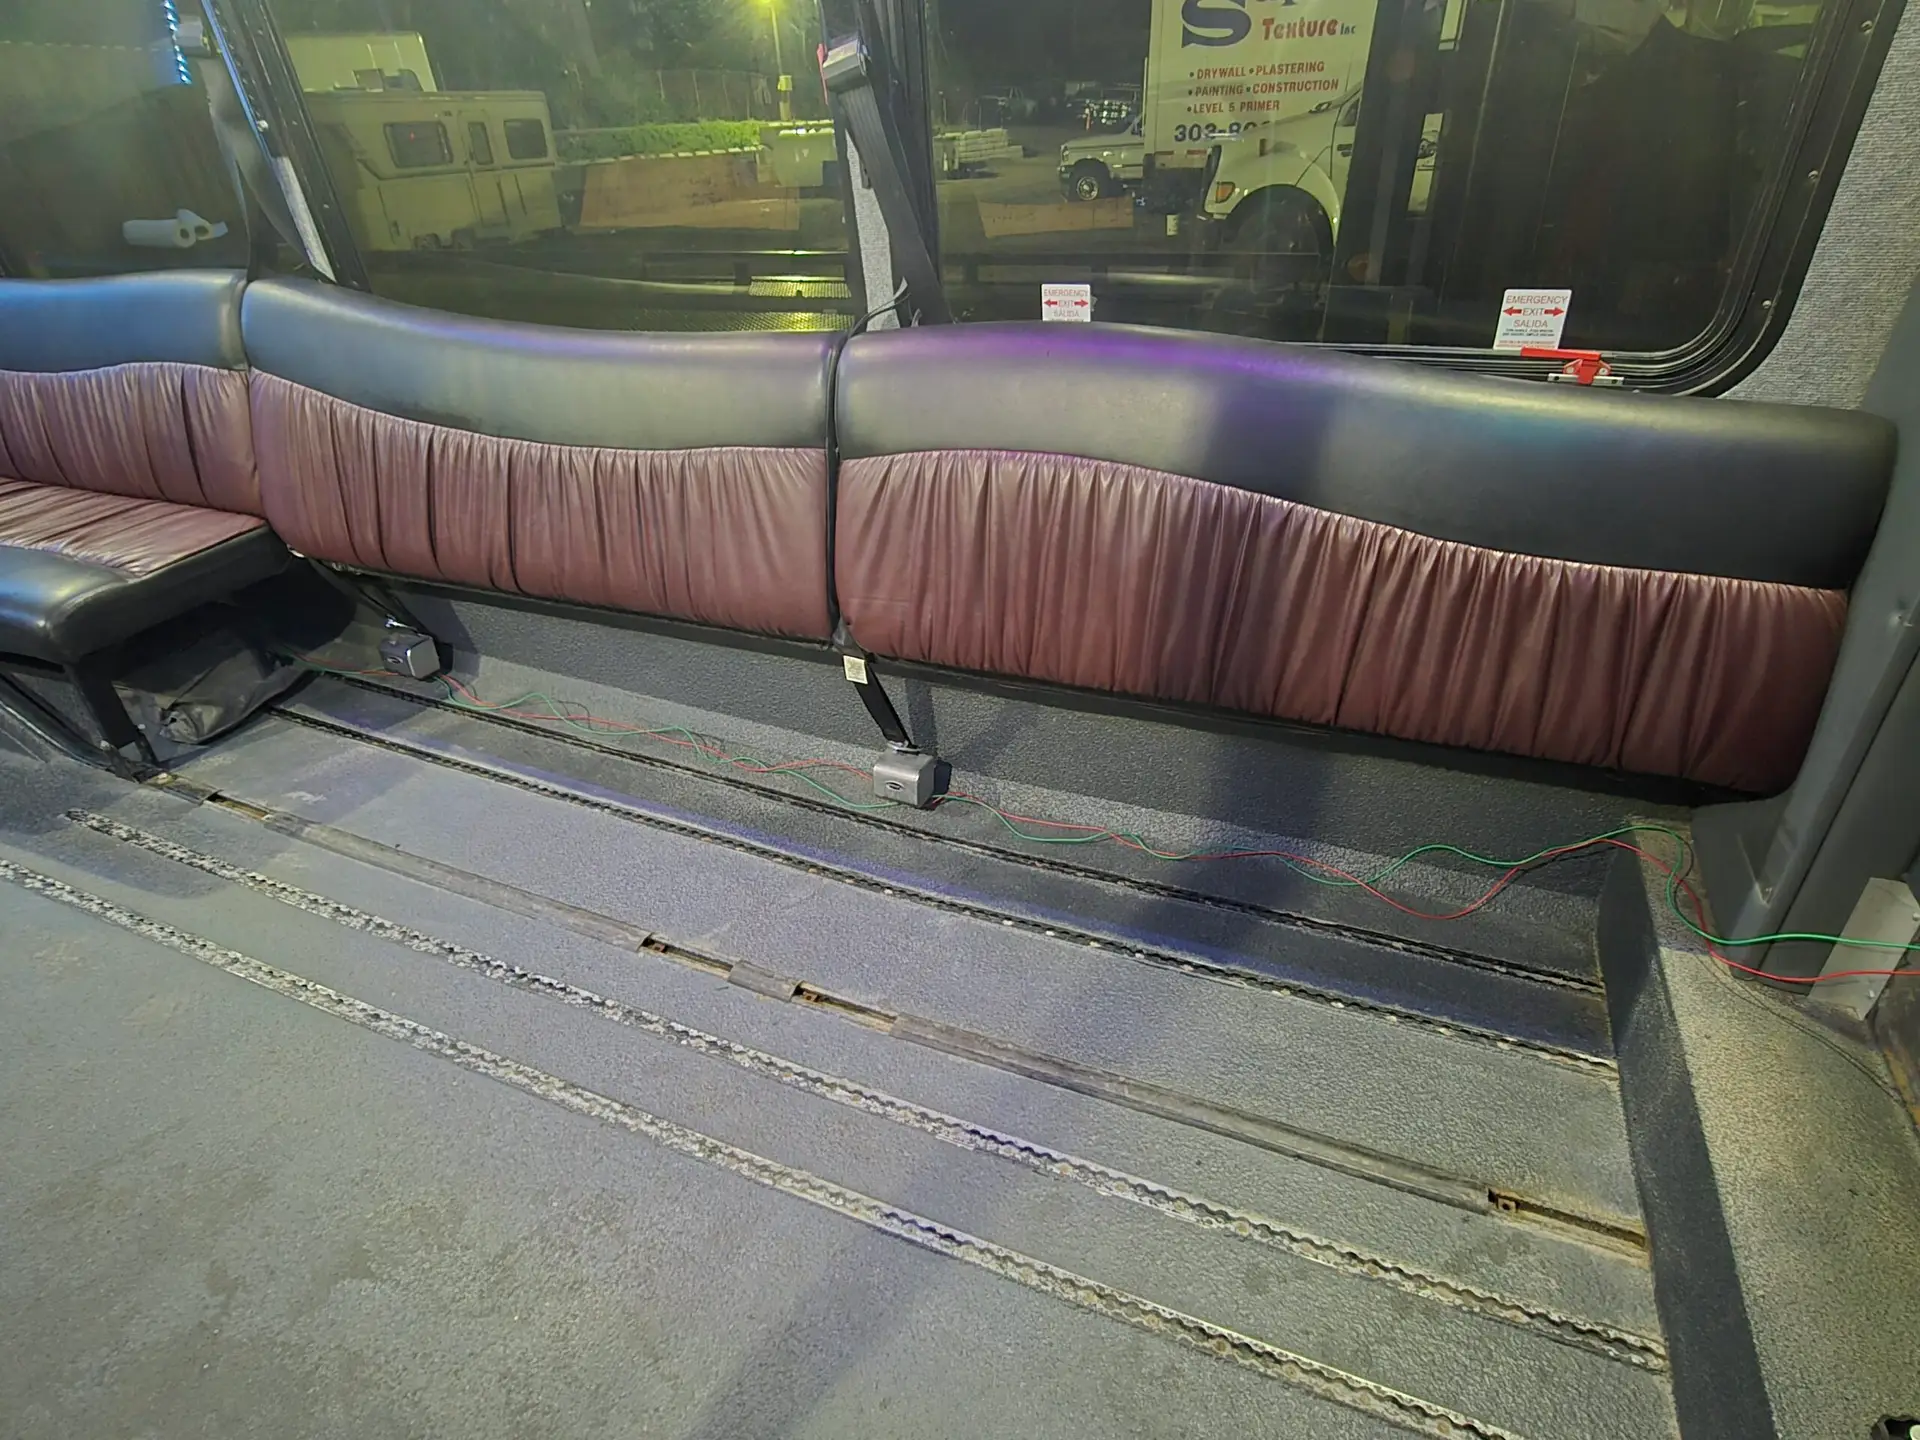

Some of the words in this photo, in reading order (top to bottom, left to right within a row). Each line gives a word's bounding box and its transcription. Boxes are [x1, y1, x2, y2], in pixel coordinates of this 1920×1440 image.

[1262, 17, 1339, 41] Texture
[1340, 25, 1356, 36] Inc
[1197, 66, 1246, 80] DRYWALL
[1256, 61, 1325, 76] PLASTERING
[1195, 84, 1244, 97] PAINTING
[1253, 79, 1339, 94] CONSTRUCTION
[1193, 102, 1224, 114] LEVEL
[1228, 102, 1236, 112] 5
[1240, 100, 1280, 112] PRIMER
[1043, 288, 1089, 297] EMERGENCY
[1505, 295, 1569, 305] EMERGENCY
[1522, 307, 1544, 316] EXIT
[1513, 319, 1548, 328] SALIDA
